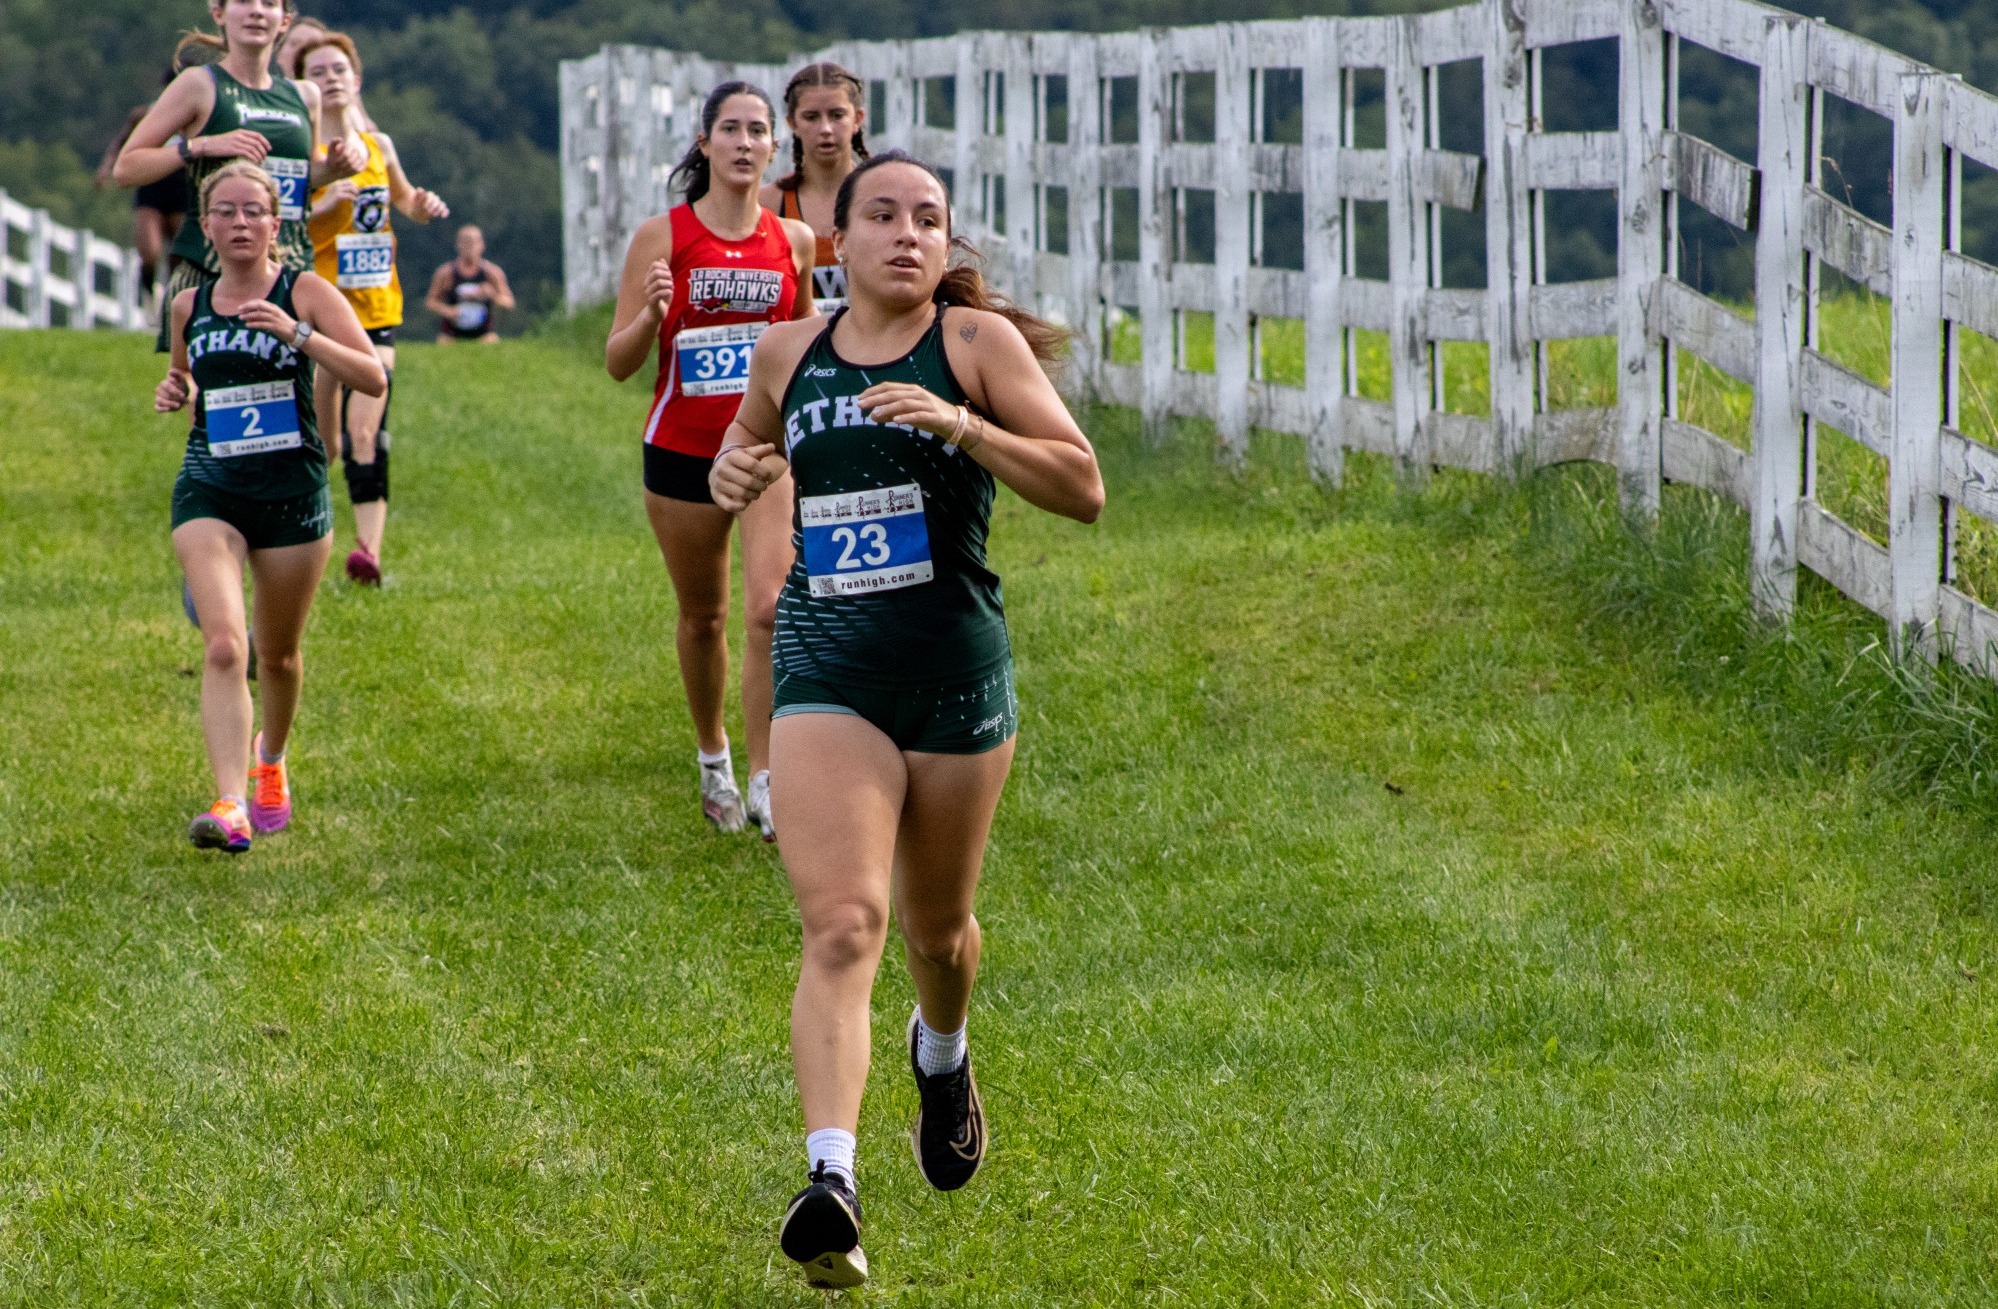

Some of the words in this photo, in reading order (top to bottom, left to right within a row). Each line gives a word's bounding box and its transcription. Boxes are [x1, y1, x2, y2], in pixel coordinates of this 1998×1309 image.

[343, 249, 391, 272] 1882
[705, 270, 732, 280] ROCHE
[734, 270, 781, 284] UNIVERSITY
[692, 280, 780, 303] REDHAWKS
[187, 329, 298, 370] THANY
[695, 345, 752, 379] 391
[241, 407, 264, 437] 2
[832, 523, 890, 570] 23
[841, 572, 915, 590] runhigh.com
